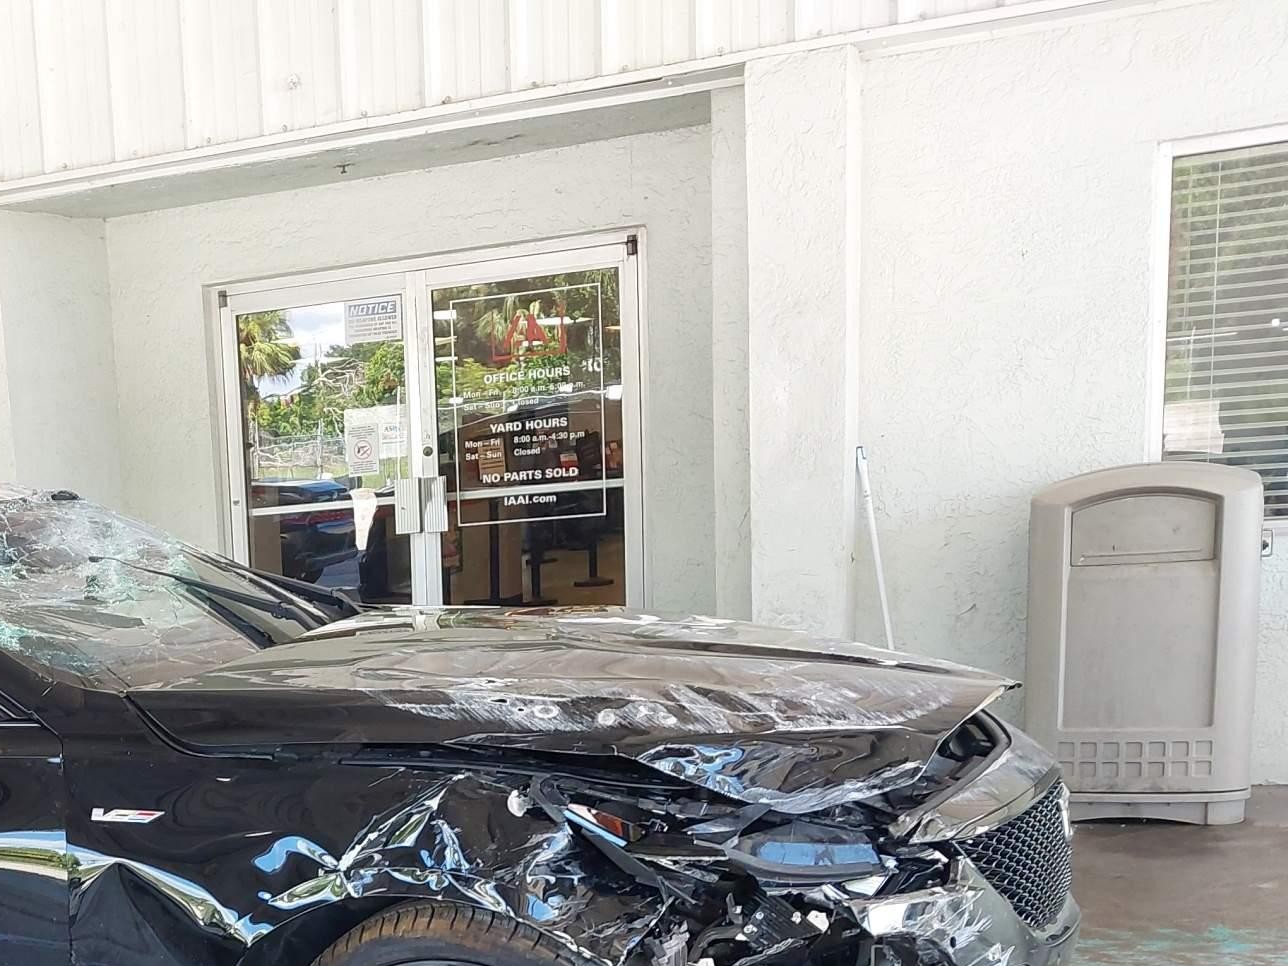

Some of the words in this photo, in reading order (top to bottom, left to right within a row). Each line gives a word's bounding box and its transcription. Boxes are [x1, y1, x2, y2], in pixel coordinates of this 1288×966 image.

[350, 302, 396, 316] NOTICE
[483, 371, 525, 384] OFFICE
[528, 366, 570, 380] HOURS
[489, 421, 522, 433] YARD
[525, 417, 568, 430] HOURS
[464, 440, 482, 448] Mon
[491, 438, 501, 446] Fri
[513, 435, 531, 443] 8:00
[465, 452, 479, 460] Sat
[486, 450, 502, 459] Sun
[513, 447, 541, 456] Closed
[482, 473, 500, 484] NO
[503, 469, 543, 482] PARTS
[545, 467, 579, 479] SOLD
[503, 494, 557, 506] IAAI.com
